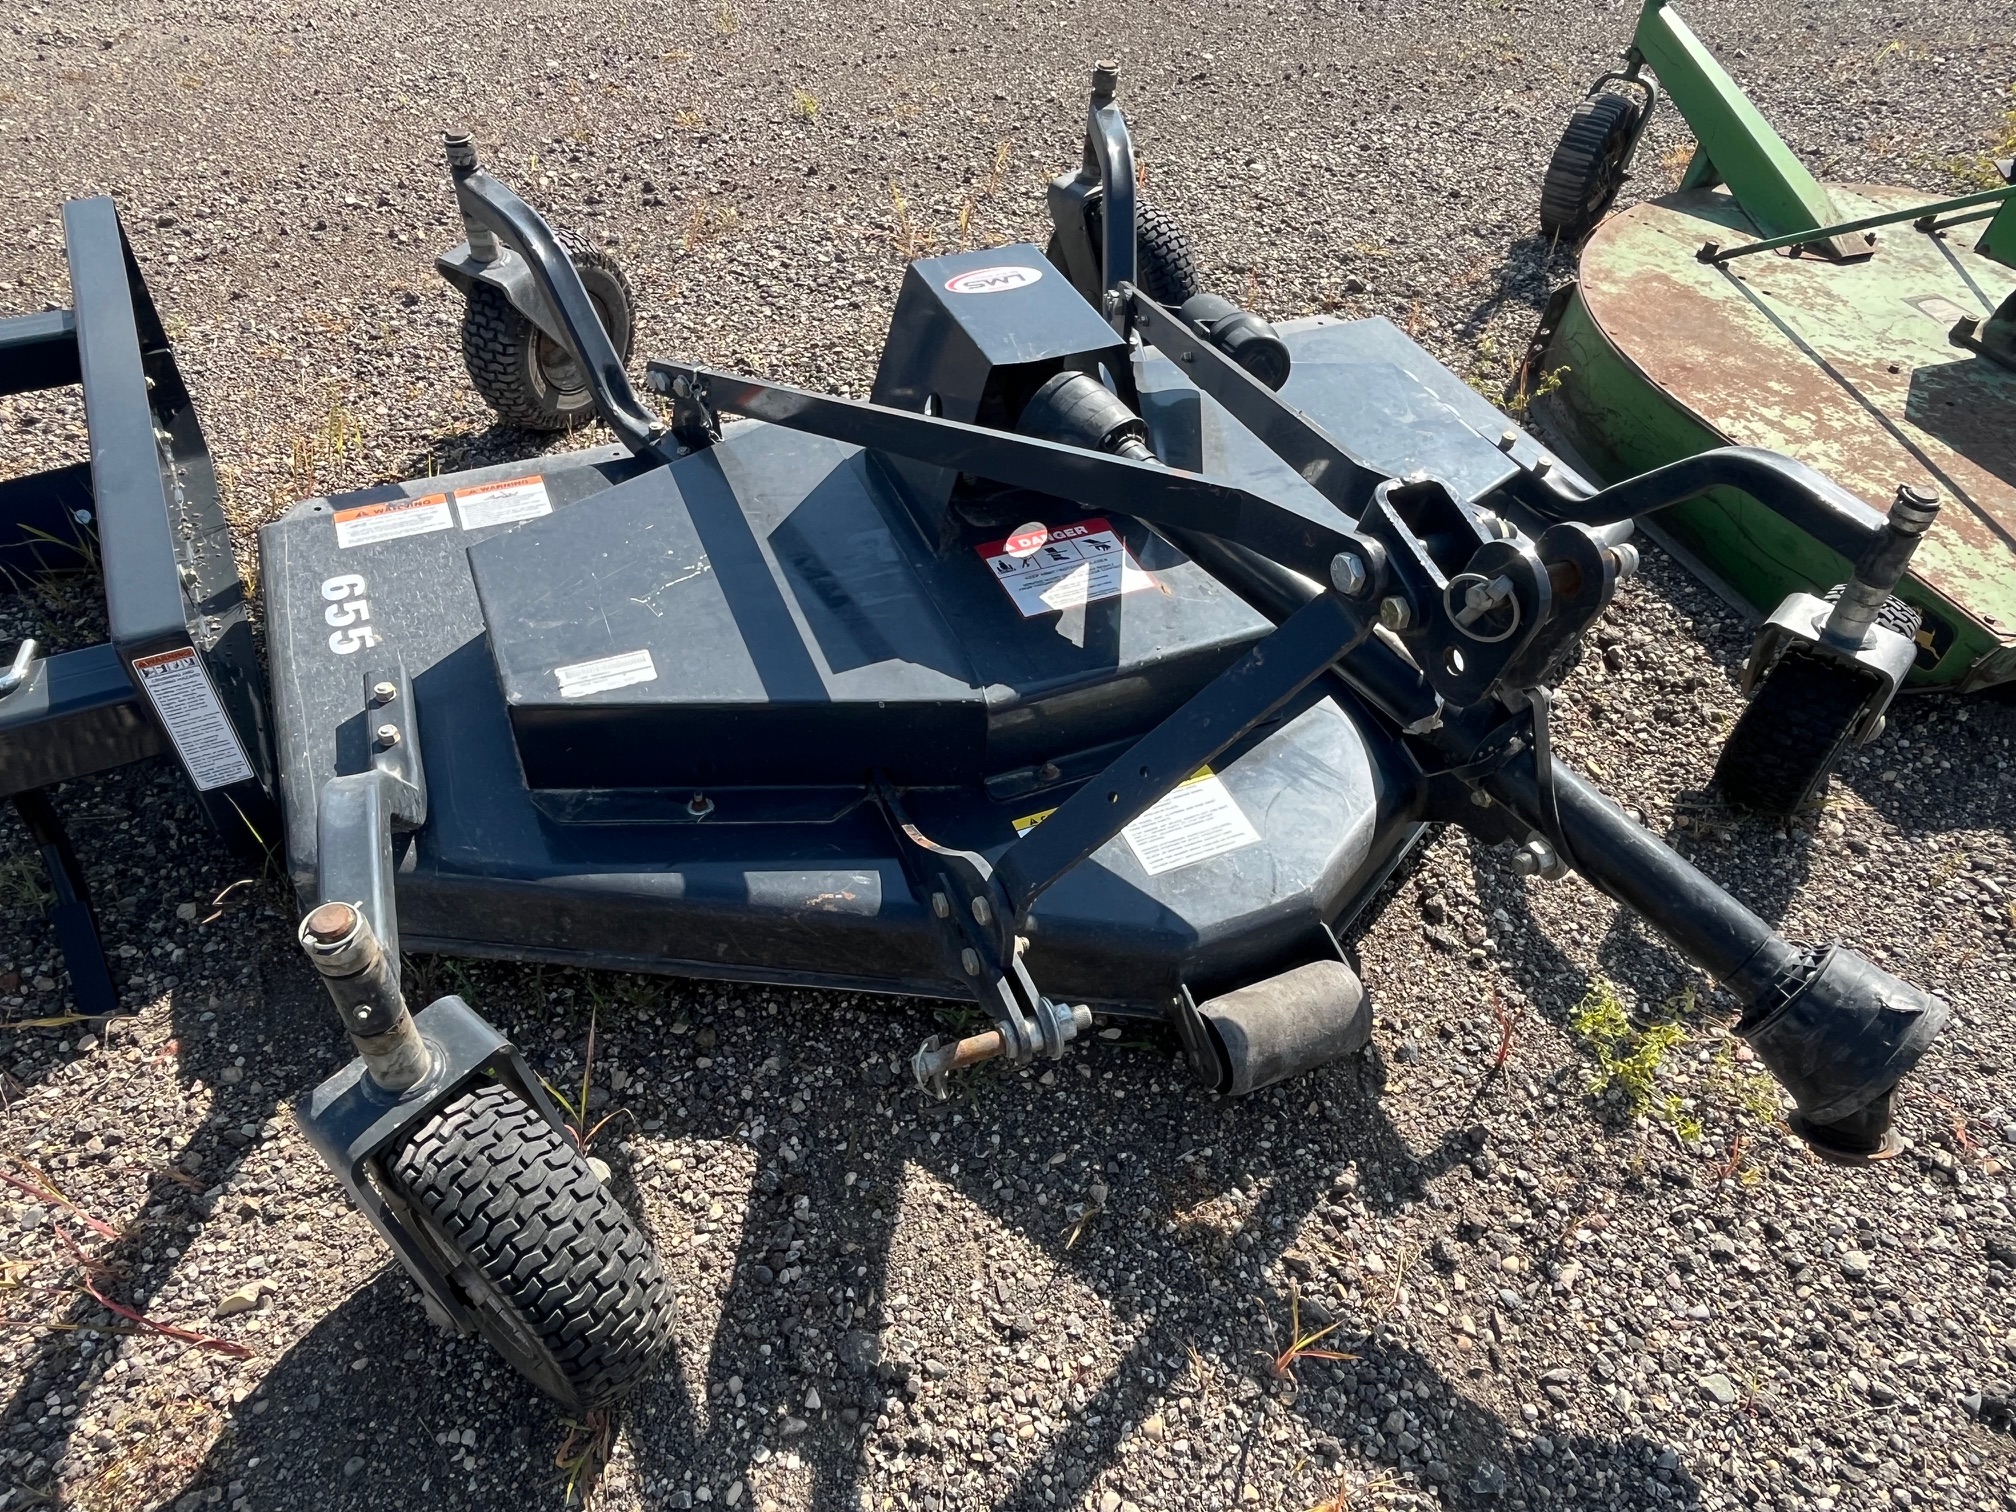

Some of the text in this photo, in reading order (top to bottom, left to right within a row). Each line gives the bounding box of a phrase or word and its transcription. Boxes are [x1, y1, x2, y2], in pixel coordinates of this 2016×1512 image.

[963, 273, 1026, 291] LMS
[478, 479, 530, 494] WARNING
[1018, 525, 1088, 548] DANGER
[321, 573, 375, 655] 655
[146, 650, 193, 665] WARNING
